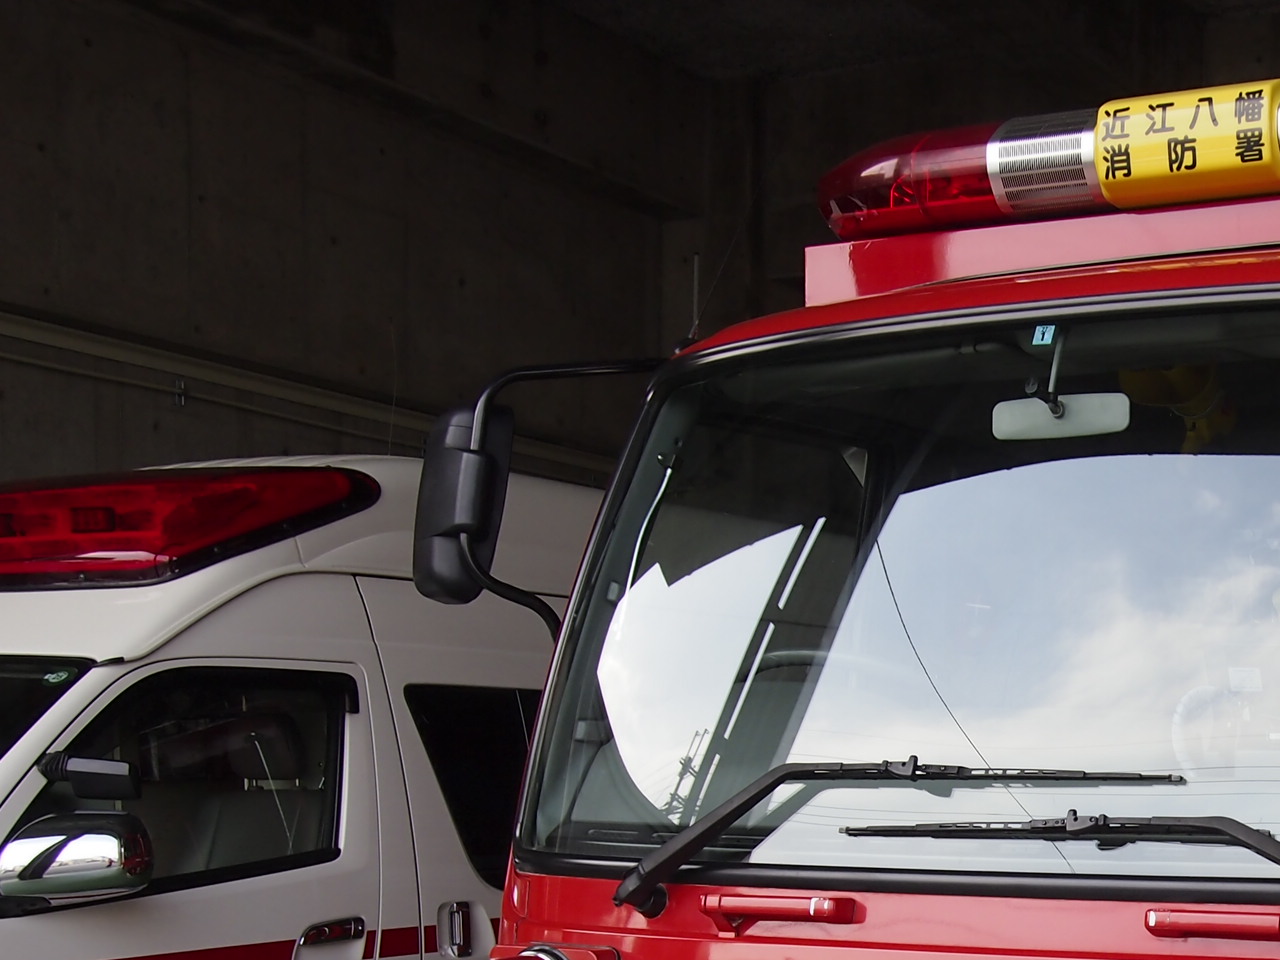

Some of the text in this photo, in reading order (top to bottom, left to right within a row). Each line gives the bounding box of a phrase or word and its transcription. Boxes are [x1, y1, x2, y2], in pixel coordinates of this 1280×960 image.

[1101, 89, 1264, 142] 近江八幡
[1102, 127, 1265, 181] 消防署
